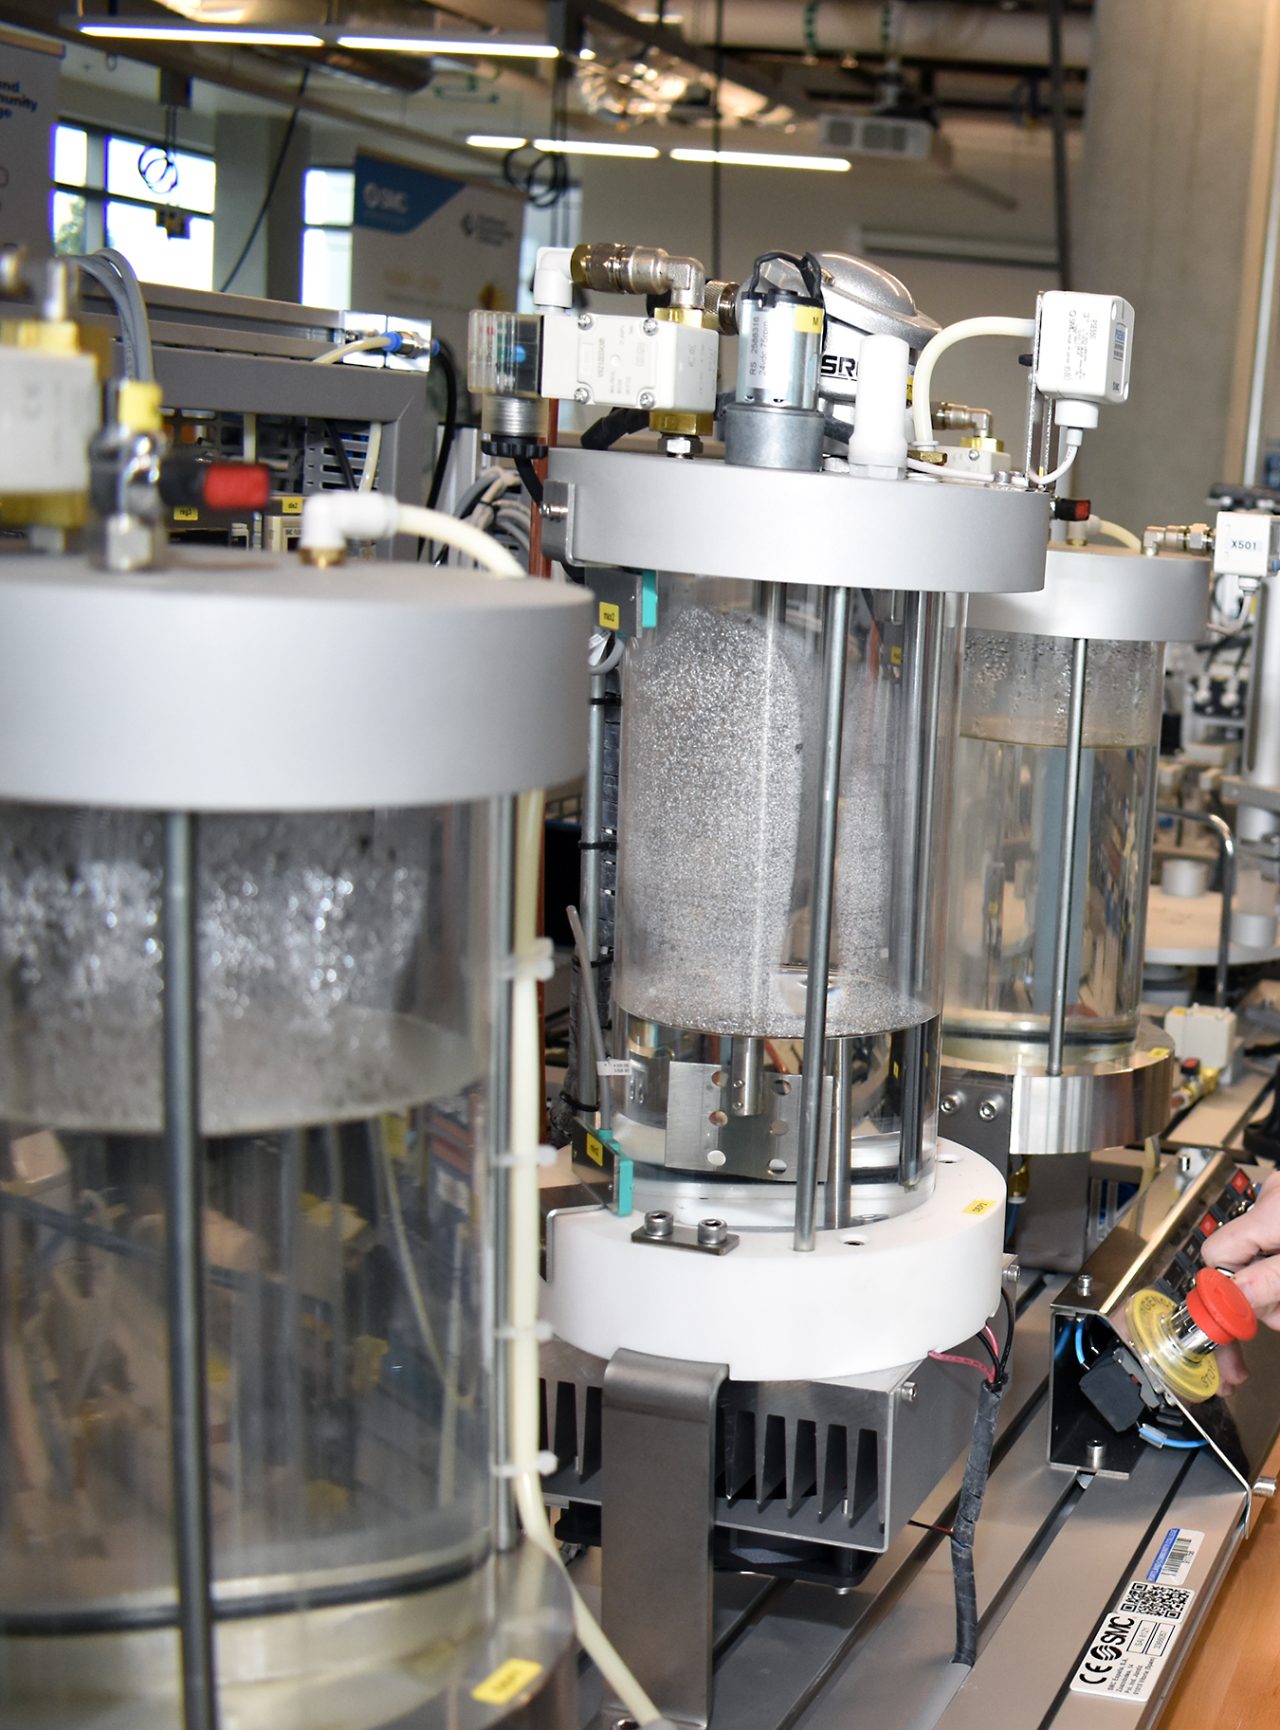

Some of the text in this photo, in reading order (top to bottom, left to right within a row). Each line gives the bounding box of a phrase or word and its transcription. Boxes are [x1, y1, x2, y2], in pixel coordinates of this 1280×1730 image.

[821, 354, 858, 378] SR
[1231, 539, 1257, 551] X501
[1100, 1616, 1135, 1645] SMC
